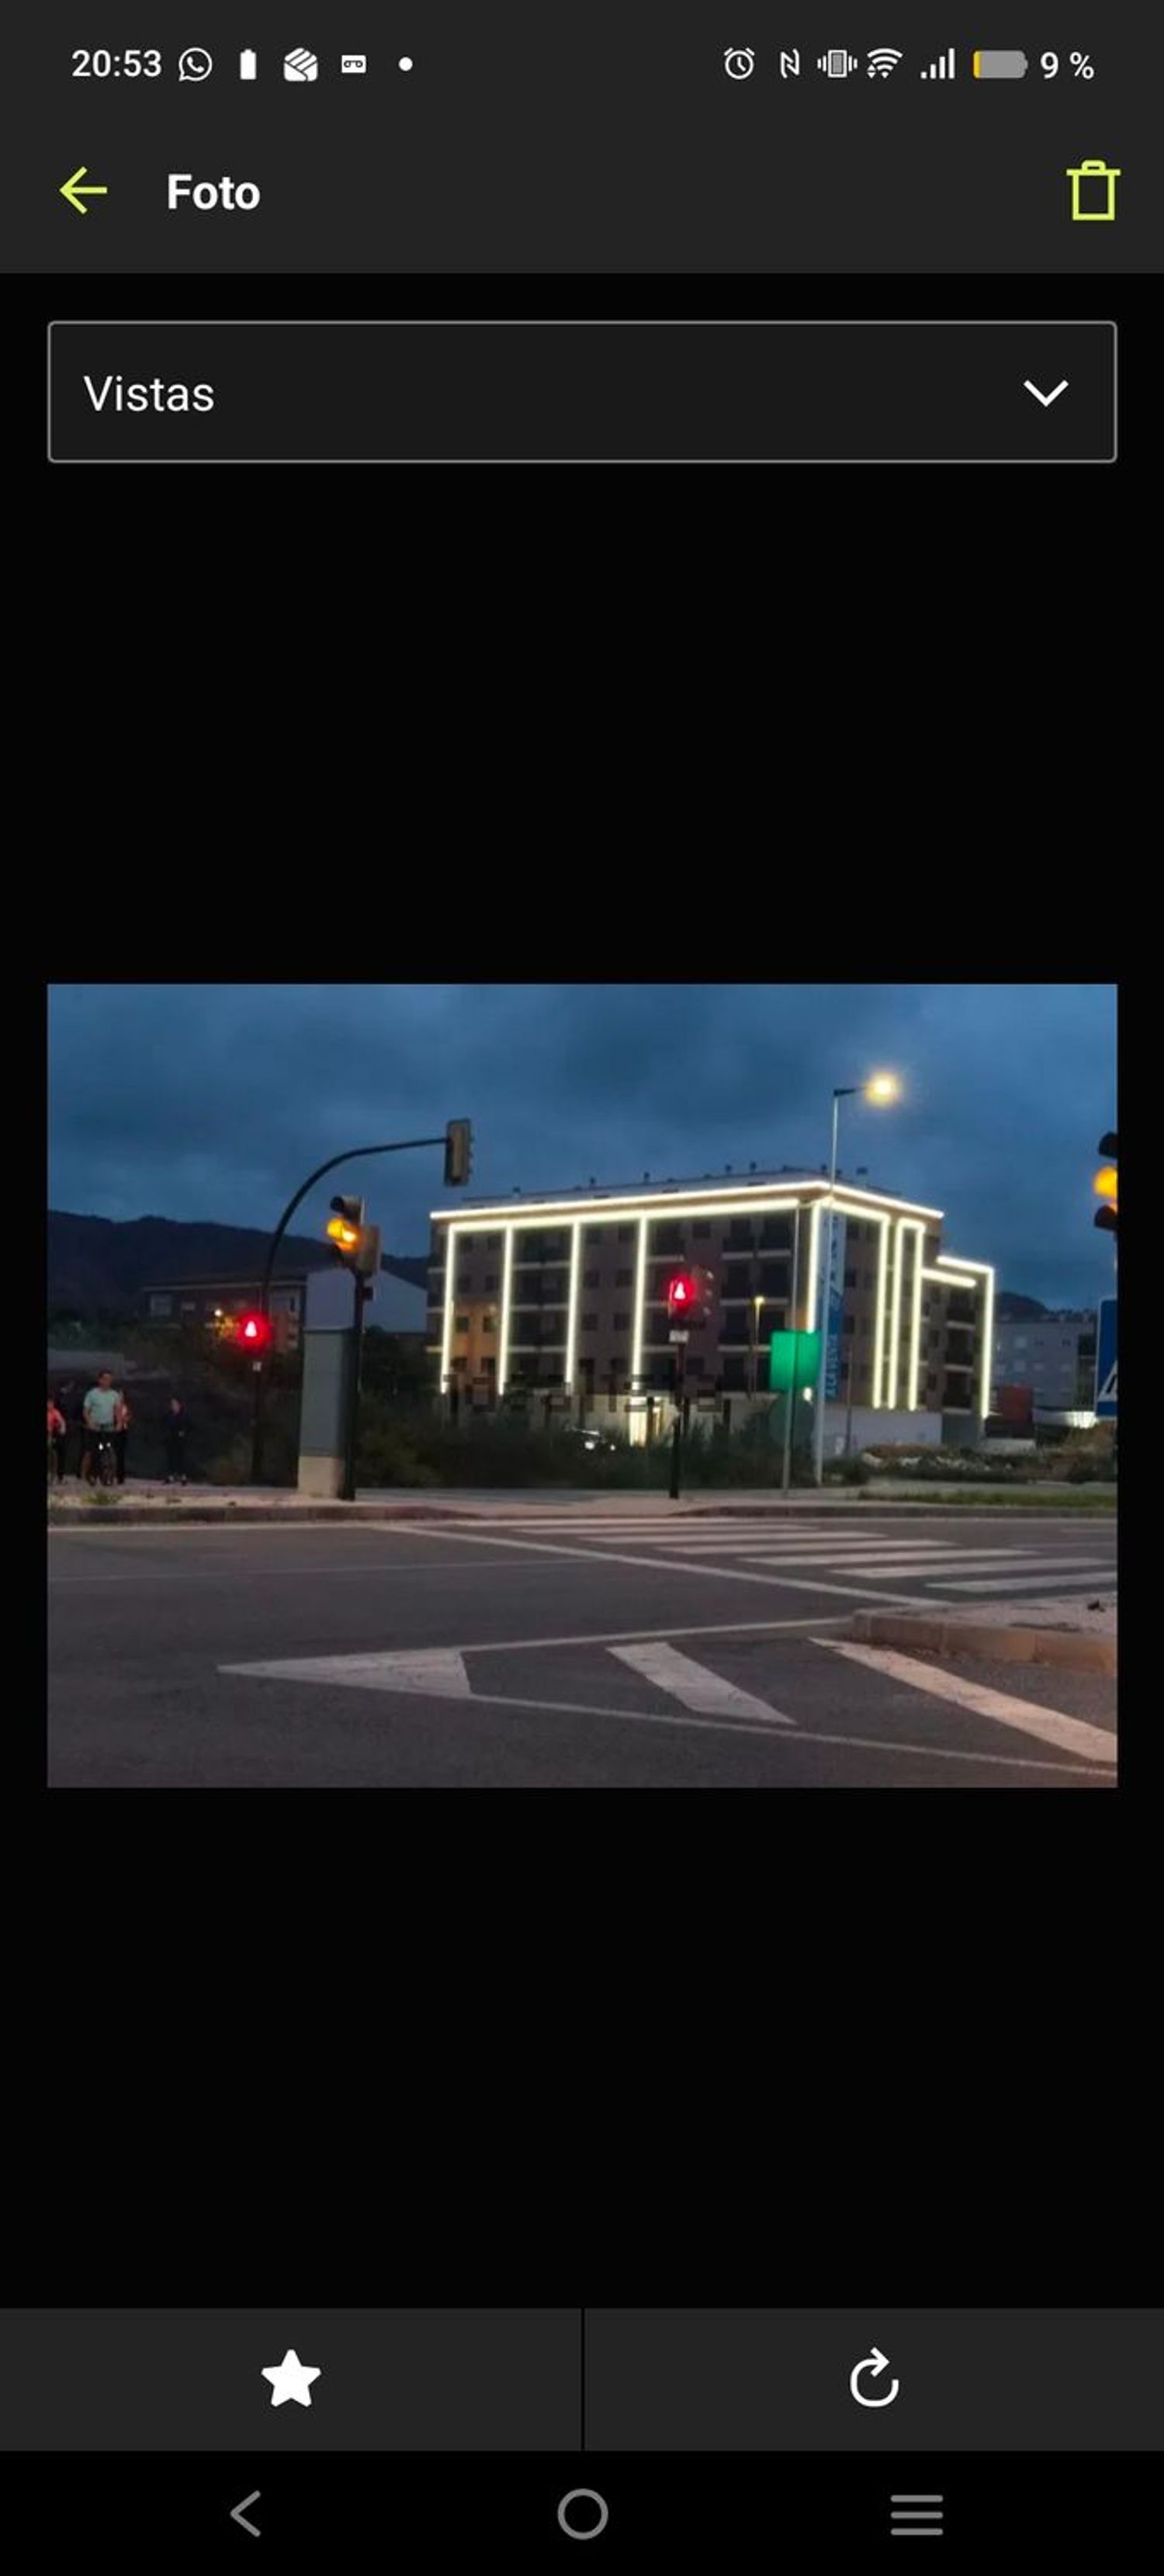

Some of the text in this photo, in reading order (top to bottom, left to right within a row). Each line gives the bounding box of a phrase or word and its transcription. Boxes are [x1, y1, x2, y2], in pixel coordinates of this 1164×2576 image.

[71, 50, 162, 77] 20:53
[1041, 52, 1095, 79] 9 %
[168, 174, 261, 210] Foto
[84, 375, 214, 412] Vistas
